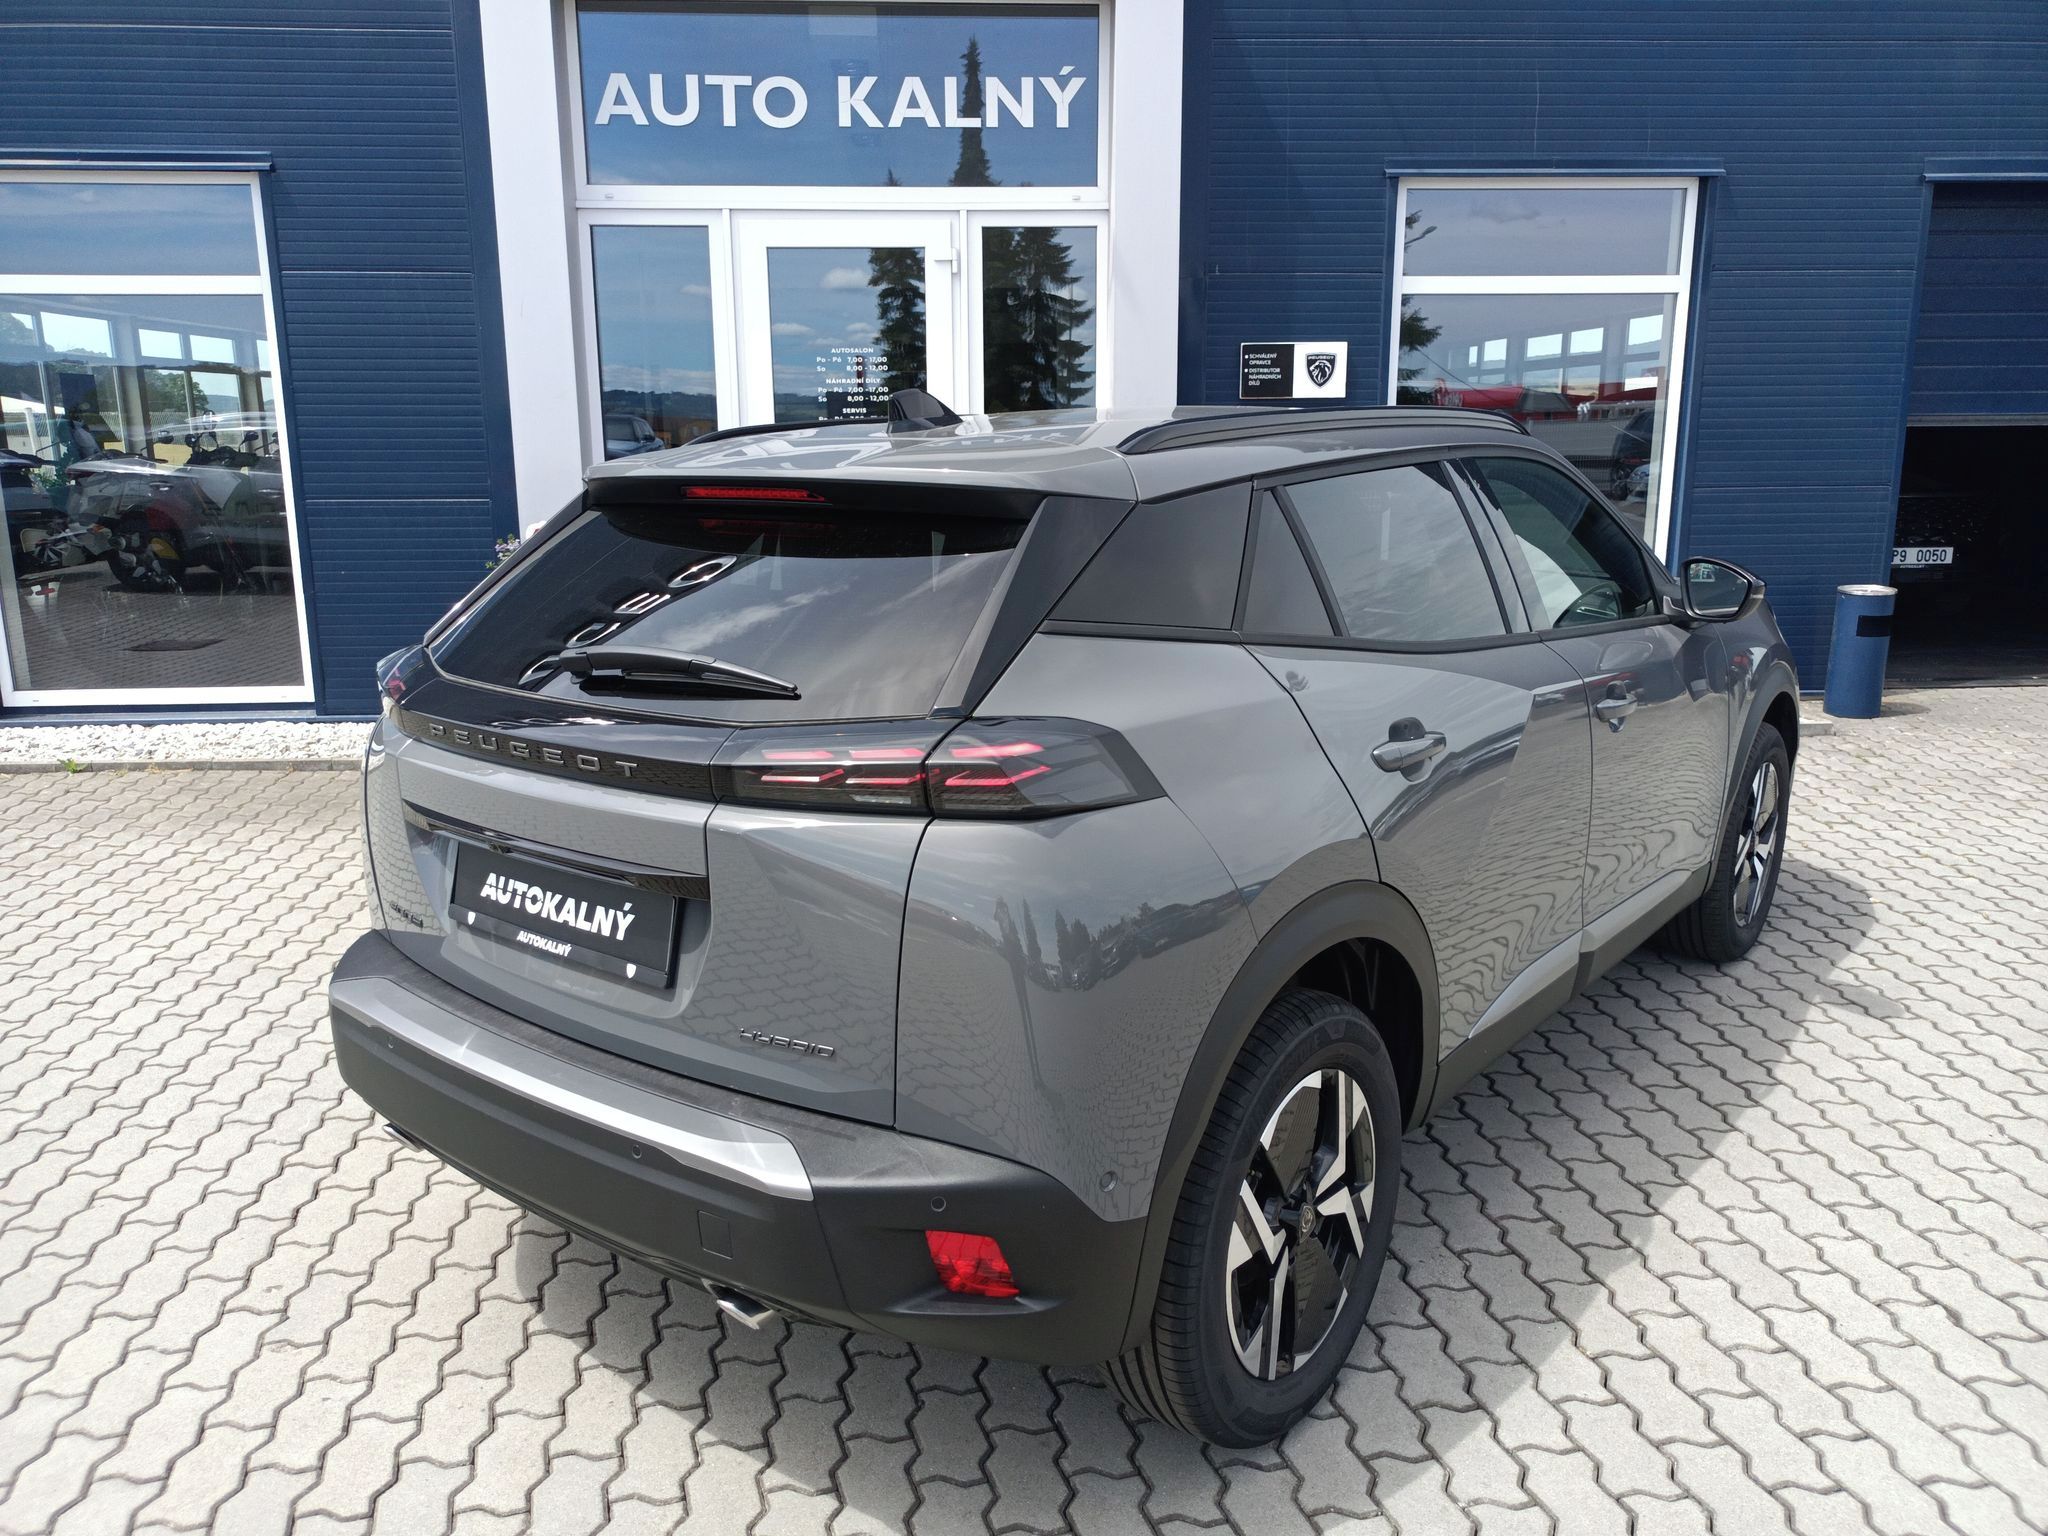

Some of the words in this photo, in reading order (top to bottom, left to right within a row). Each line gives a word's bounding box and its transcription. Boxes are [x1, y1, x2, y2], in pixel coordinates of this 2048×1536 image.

[594, 72, 808, 129] AUTO
[838, 66, 1086, 128] KALNÝ
[1916, 549, 1947, 562] 0050
[429, 722, 639, 777] PEUGEOT
[480, 872, 635, 941] AUTOKALNÝ
[516, 930, 572, 957] AUTOKALNÝ
